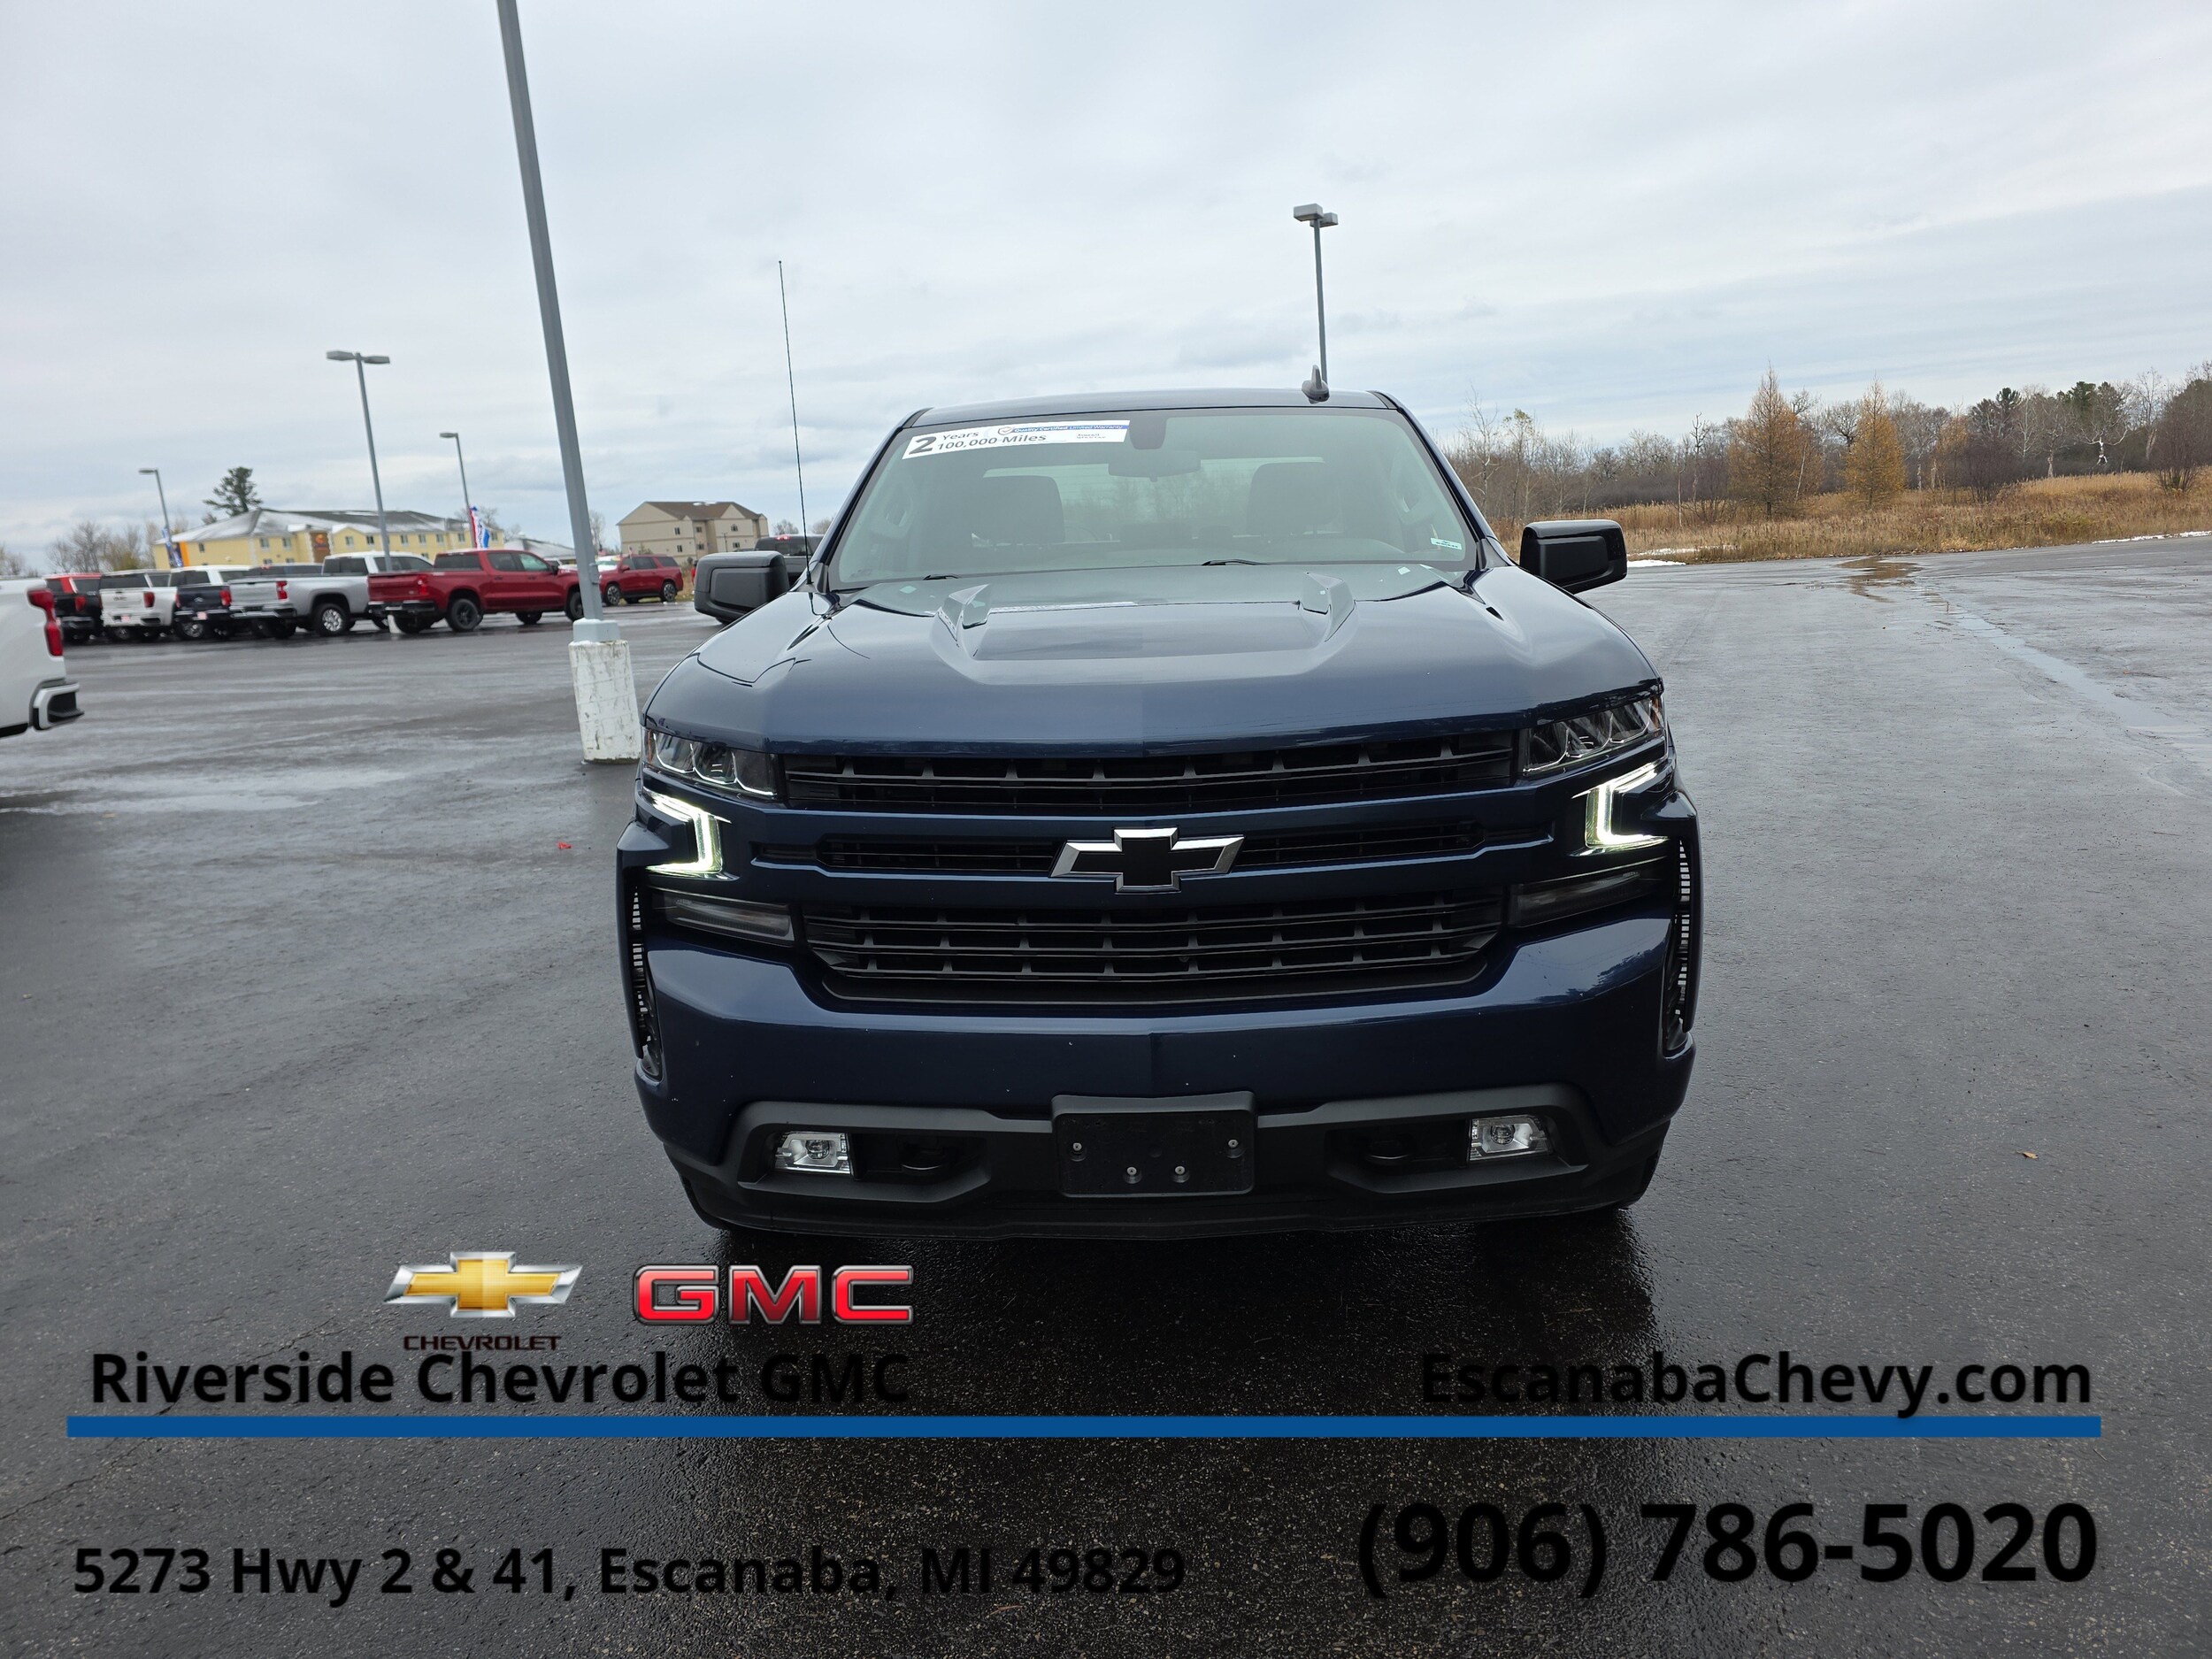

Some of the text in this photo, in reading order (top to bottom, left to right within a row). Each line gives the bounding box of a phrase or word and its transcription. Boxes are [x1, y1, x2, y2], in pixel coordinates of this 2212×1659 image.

[937, 434, 1048, 450] 100,000 Miles
[942, 431, 979, 441] Years
[909, 436, 937, 455] 2
